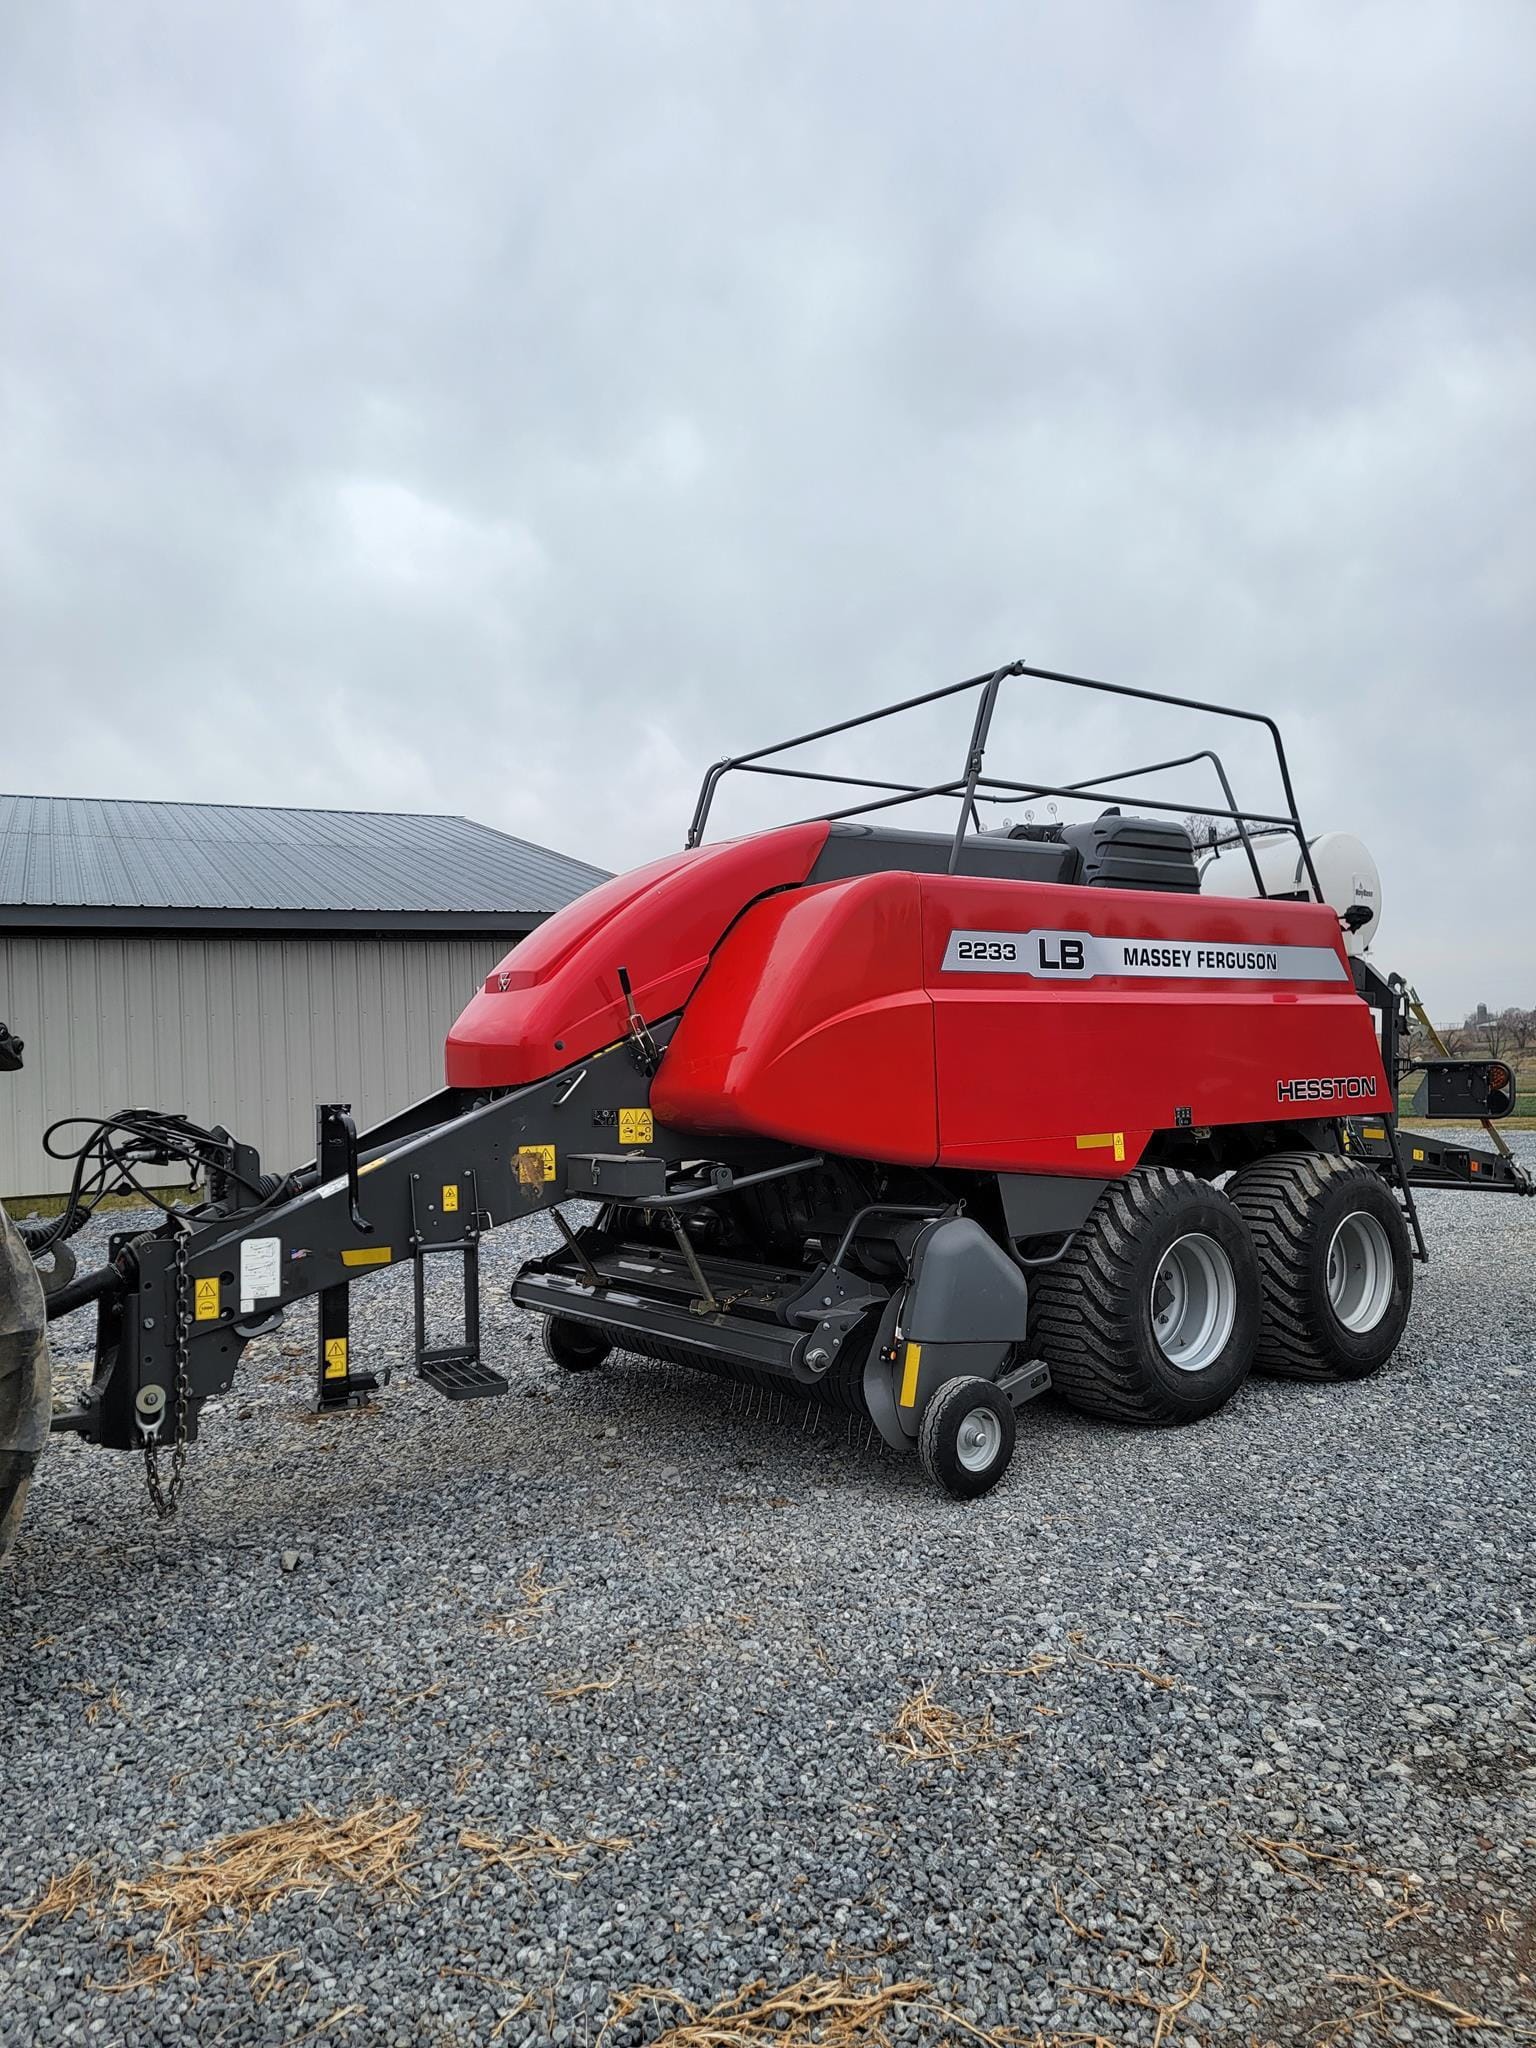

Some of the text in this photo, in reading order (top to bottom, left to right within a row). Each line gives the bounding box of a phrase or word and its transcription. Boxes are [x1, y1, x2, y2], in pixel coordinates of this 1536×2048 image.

[958, 938, 1278, 970] 2233 LB MASSEY FERGUSON
[1277, 1076, 1376, 1102] HESSTON
